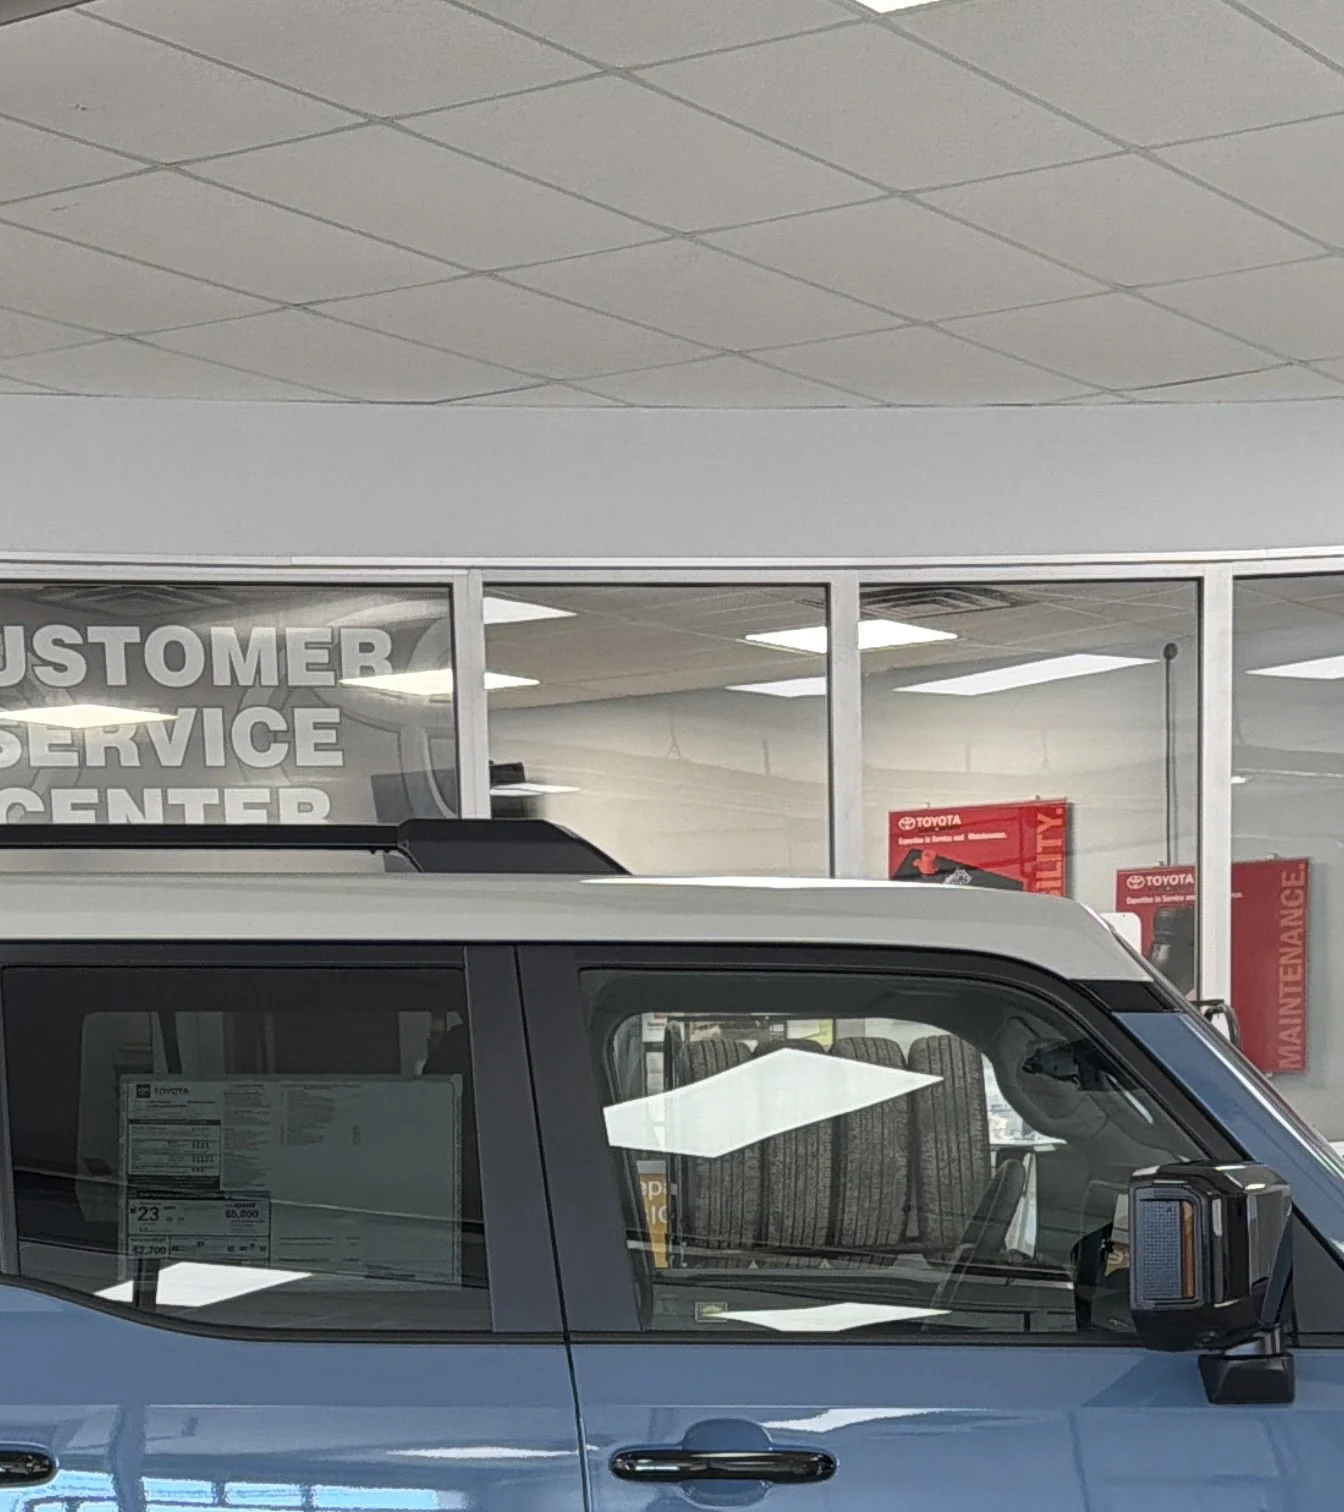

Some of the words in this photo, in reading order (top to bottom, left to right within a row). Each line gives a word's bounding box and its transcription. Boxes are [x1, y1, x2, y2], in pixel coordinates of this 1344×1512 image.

[916, 814, 962, 828] TOYOTA
[1036, 807, 1064, 896] ILITY.
[1146, 874, 1194, 887] TOYOTA
[1278, 863, 1306, 1070] MAINTENANCE.
[137, 1206, 160, 1222] 23
